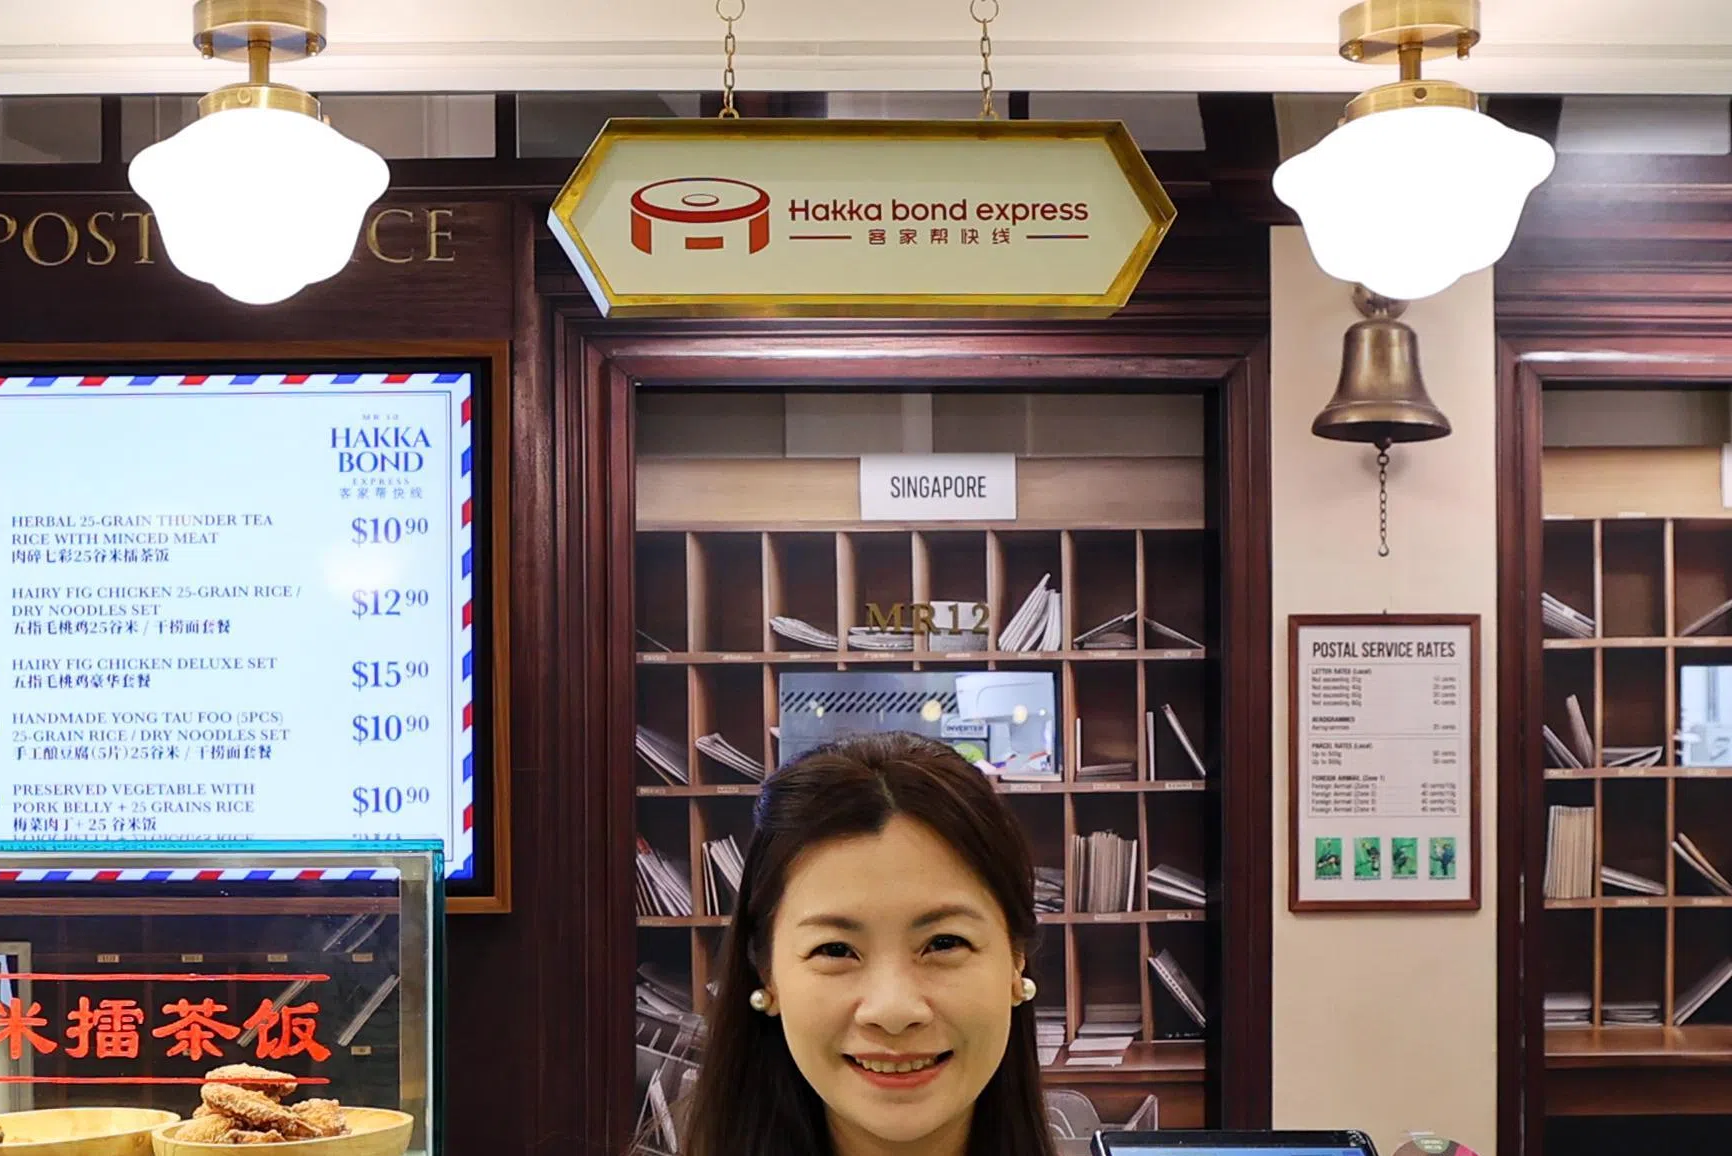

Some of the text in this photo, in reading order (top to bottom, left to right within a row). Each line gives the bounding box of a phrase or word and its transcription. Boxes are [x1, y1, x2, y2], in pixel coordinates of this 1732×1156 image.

[788, 197, 1089, 227] Hakka bond express
[867, 228, 1012, 246] 客家帮快线
[330, 427, 432, 449] HAKKA
[338, 451, 424, 473] BOND
[352, 477, 410, 486] EXPRESS
[890, 475, 987, 499] SINGAPORE
[12, 514, 273, 528] HERBAL 25-GRAIN THUNDER TEA
[12, 531, 220, 545] RICE WITH MINCED MEAT
[11, 587, 62, 599] HAIRY
[66, 587, 92, 599] FIG
[97, 586, 172, 599] CHICKEN
[177, 586, 249, 598] 25-GRAIN
[253, 585, 293, 598] RICE
[11, 604, 162, 617] DRY NOODLES SET
[865, 602, 991, 636] MR12
[1312, 641, 1455, 658] POSTAL SERVICE RATES
[12, 657, 278, 670] HAIRY FIG CHICKEN DELUXE SET
[12, 711, 284, 725] HANDMADE YONG TAU FOO (5PCS)
[12, 730, 84, 742] 25-GRAIN
[89, 730, 127, 742] RICE
[140, 730, 173, 742] DRY
[177, 729, 256, 742] NOODLES
[260, 729, 291, 741] SET
[12, 783, 256, 796] PRESERVED VEGETABLE WITH
[12, 801, 58, 814] PORK
[63, 801, 114, 814] BELLY
[131, 801, 147, 813] 25
[151, 801, 212, 814] GRAINS
[216, 801, 255, 813] RICE
